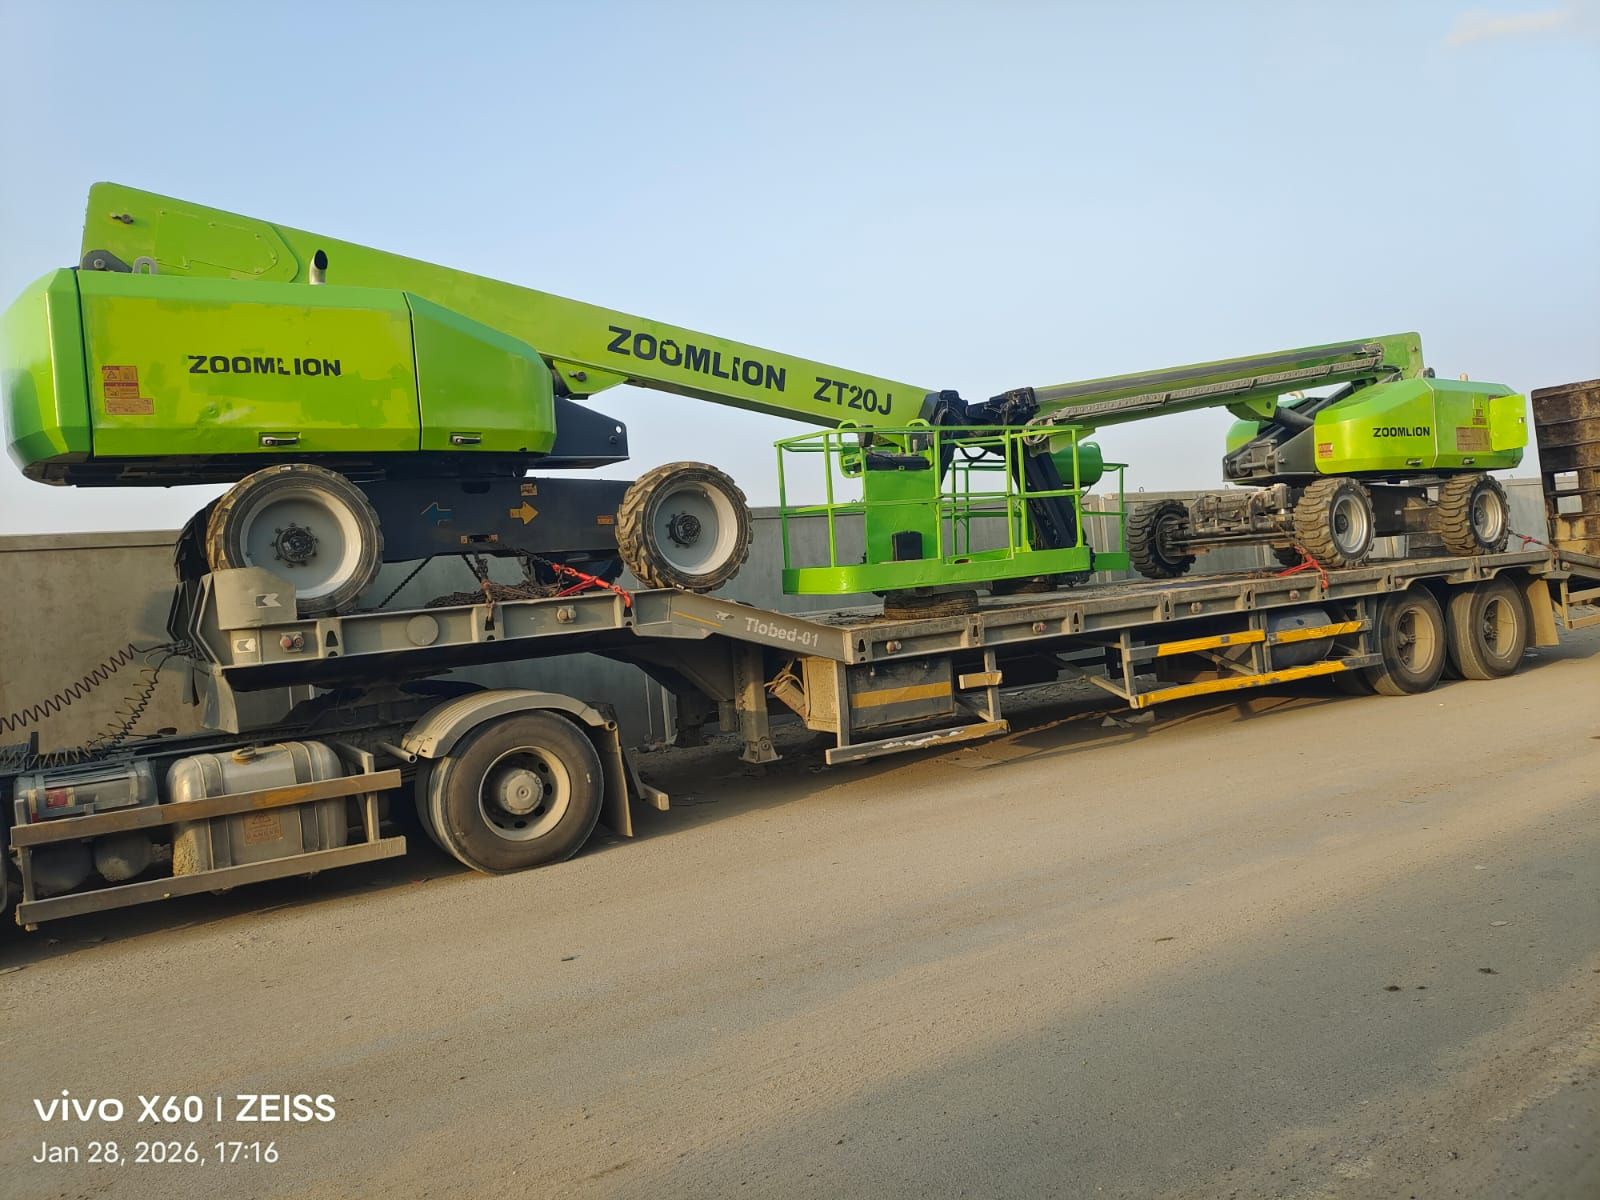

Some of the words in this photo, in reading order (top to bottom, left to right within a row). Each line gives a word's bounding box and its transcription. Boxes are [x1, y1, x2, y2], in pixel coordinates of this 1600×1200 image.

[187, 355, 342, 377] ZOOMLION
[607, 325, 787, 392] ZOOMLION
[813, 376, 892, 416] ZT20J
[1372, 426, 1430, 438] ZOOMLION
